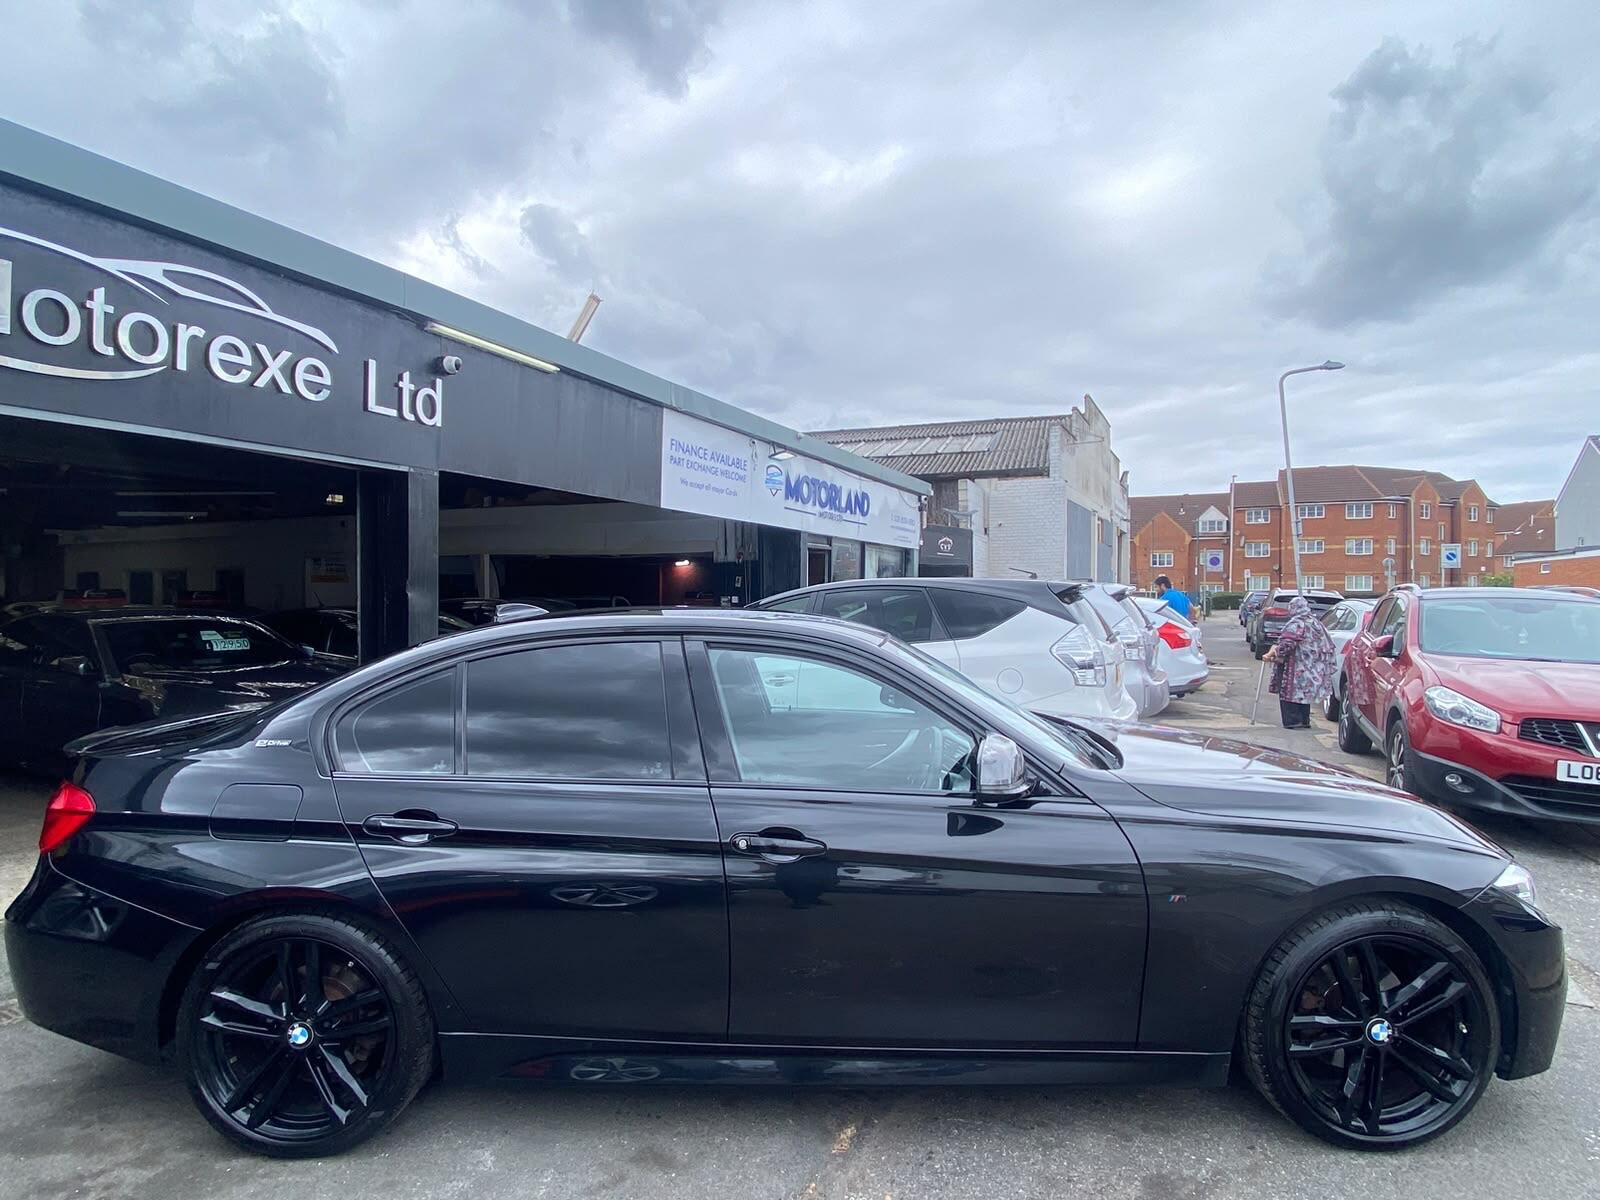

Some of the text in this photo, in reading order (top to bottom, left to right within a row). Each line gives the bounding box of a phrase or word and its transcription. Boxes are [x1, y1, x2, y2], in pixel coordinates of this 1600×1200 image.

[0, 258, 443, 427] otorexe Ltd
[669, 455, 747, 483] PART EXCHANGE WELCOME
[670, 438, 748, 471] FINANCE AVAILABLE
[784, 469, 870, 517] MOTORLAND
